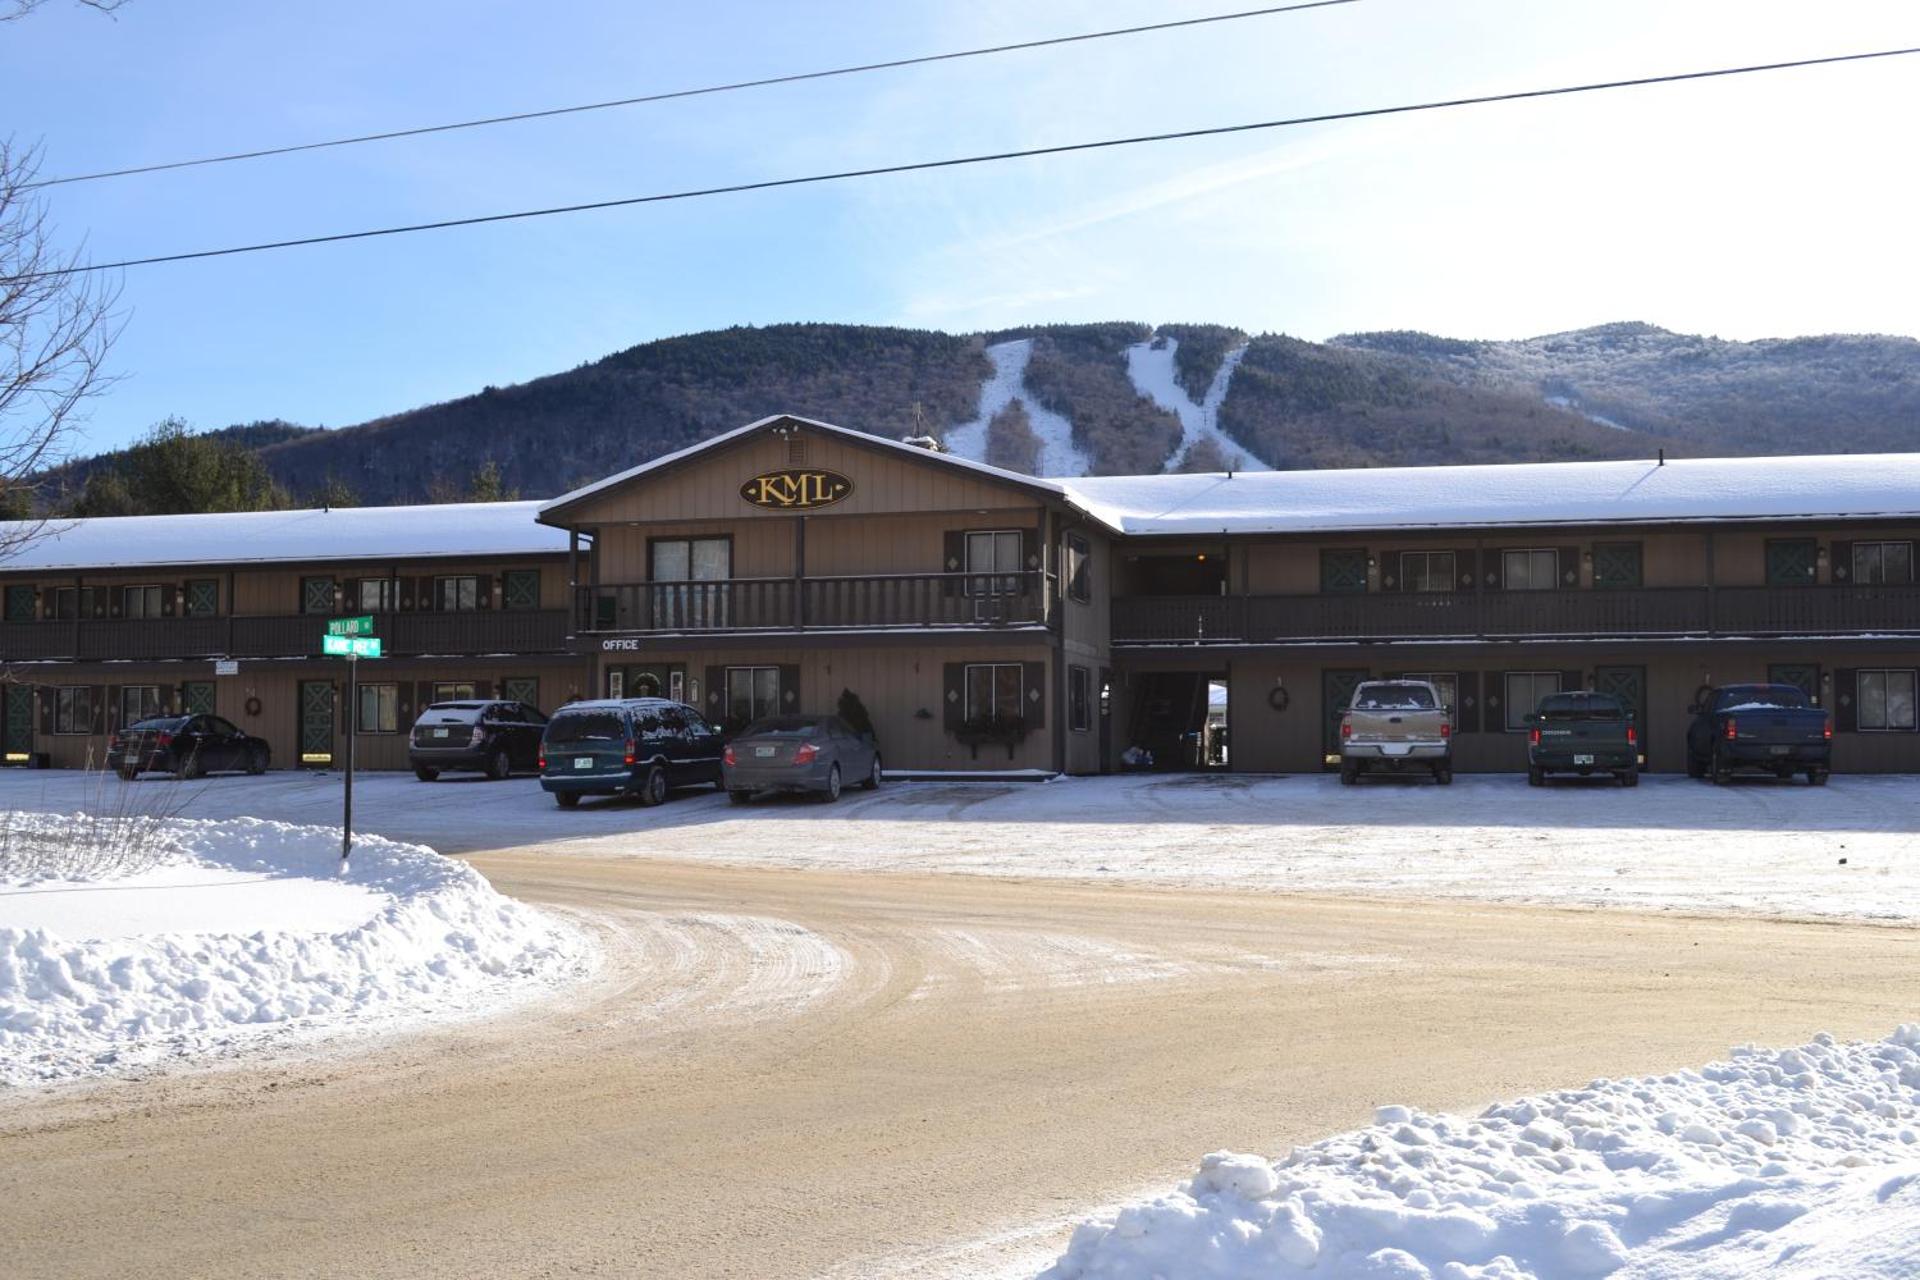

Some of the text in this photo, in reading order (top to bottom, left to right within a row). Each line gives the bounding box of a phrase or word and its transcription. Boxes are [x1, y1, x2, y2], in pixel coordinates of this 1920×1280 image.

[756, 474, 833, 505] KML
[328, 620, 359, 635] POLLARD
[602, 639, 639, 650] OFFICE
